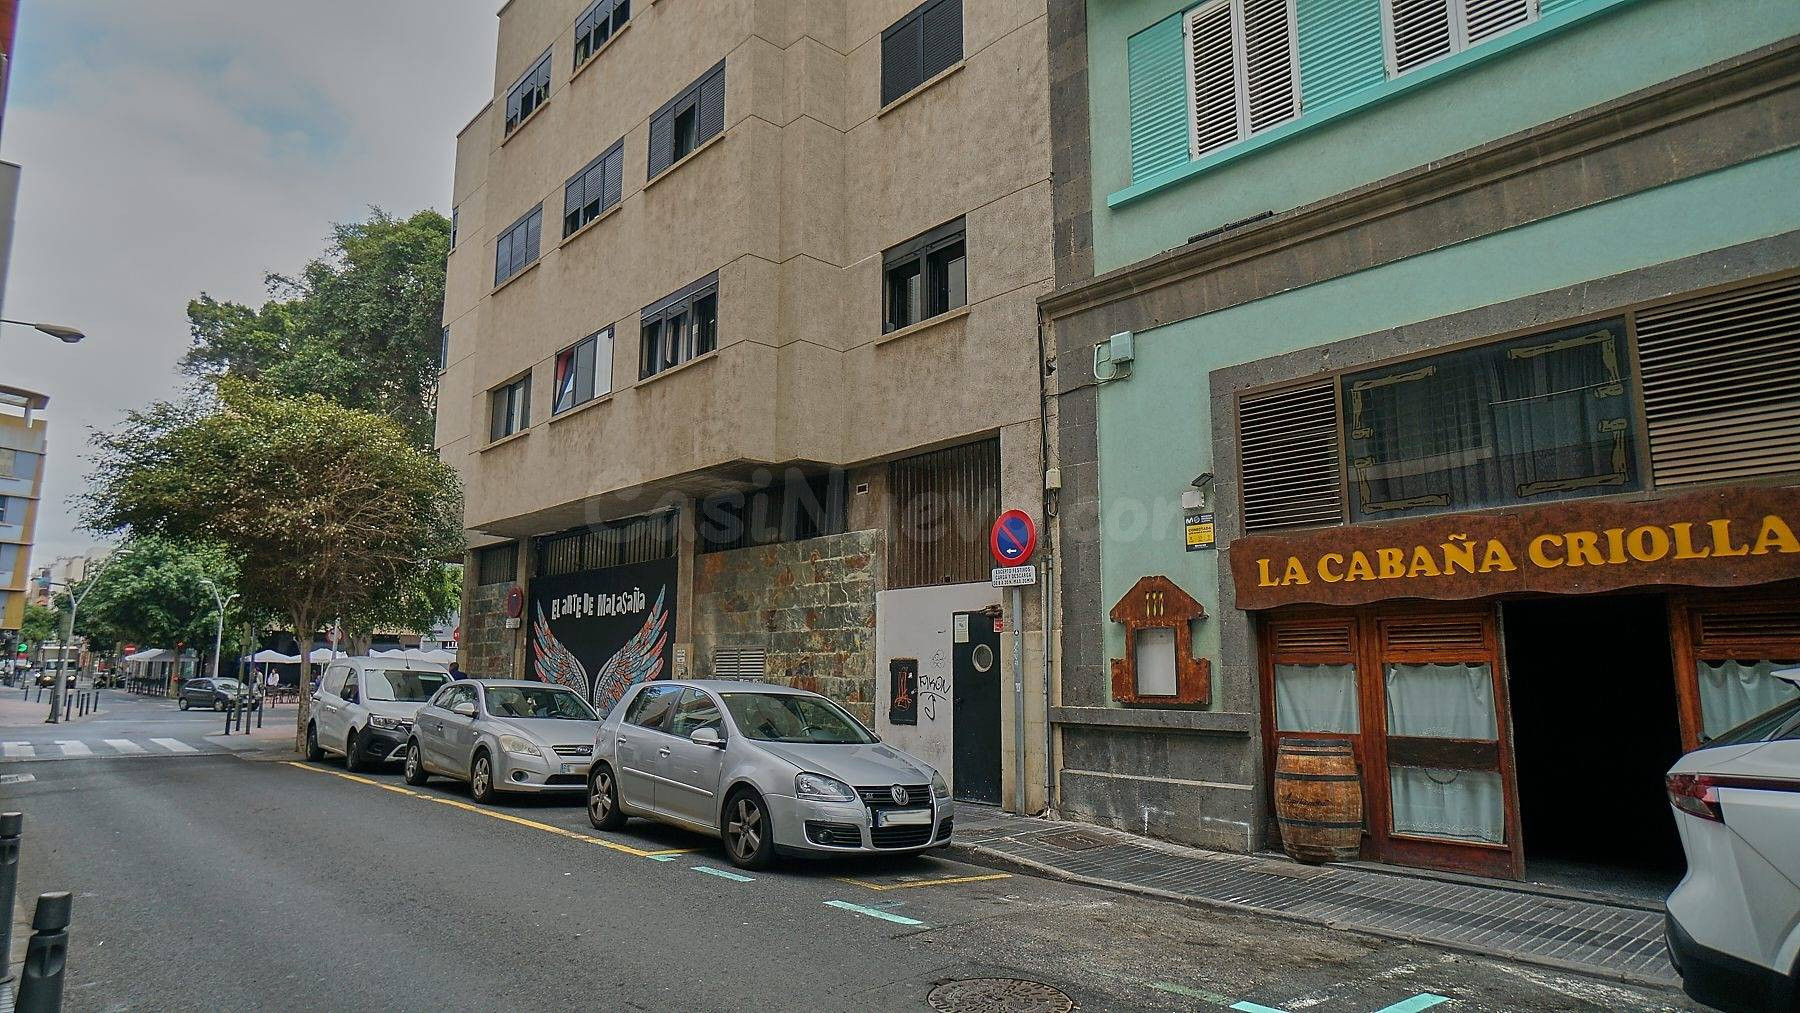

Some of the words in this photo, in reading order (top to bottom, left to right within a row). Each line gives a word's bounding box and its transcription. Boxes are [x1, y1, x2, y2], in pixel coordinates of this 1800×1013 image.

[1256, 556, 1312, 587] LA
[1317, 533, 1517, 583] CABAÑA
[1528, 515, 1800, 568] CRIOLLA
[551, 599, 560, 620] EL
[583, 593, 594, 616] DE
